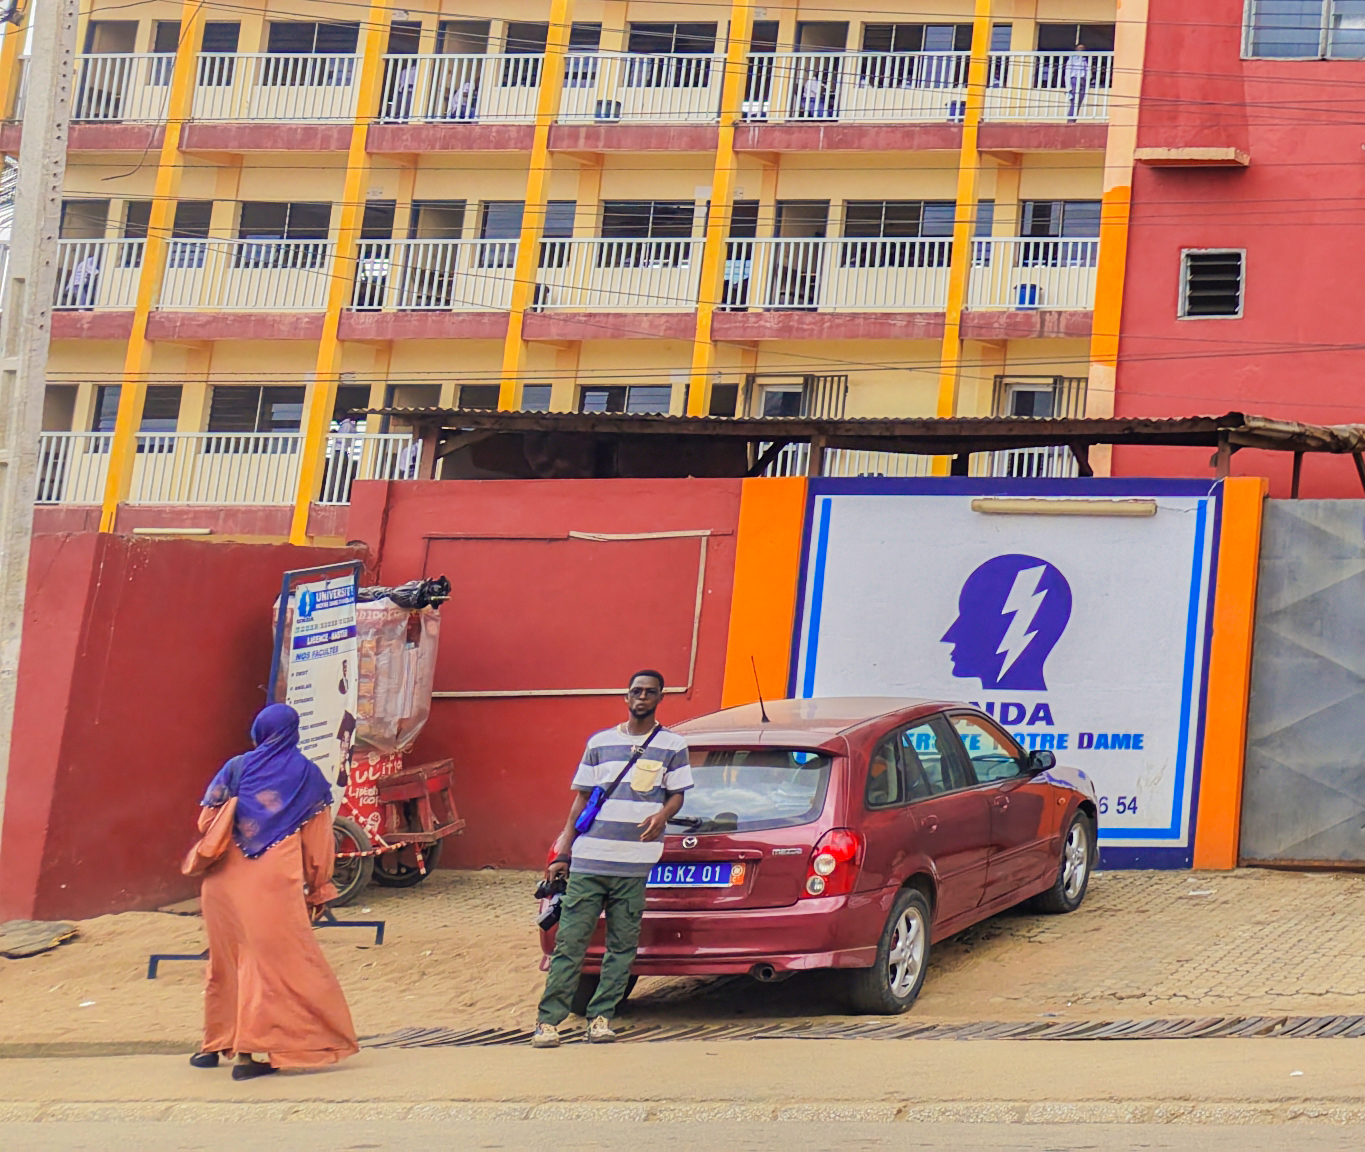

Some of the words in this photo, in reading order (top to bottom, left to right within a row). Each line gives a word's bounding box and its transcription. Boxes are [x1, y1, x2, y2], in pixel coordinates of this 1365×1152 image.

[1077, 732, 1144, 750] DAME
[1116, 796, 1138, 815] 54
[676, 866, 697, 882] KZ
[702, 866, 721, 882] 01
